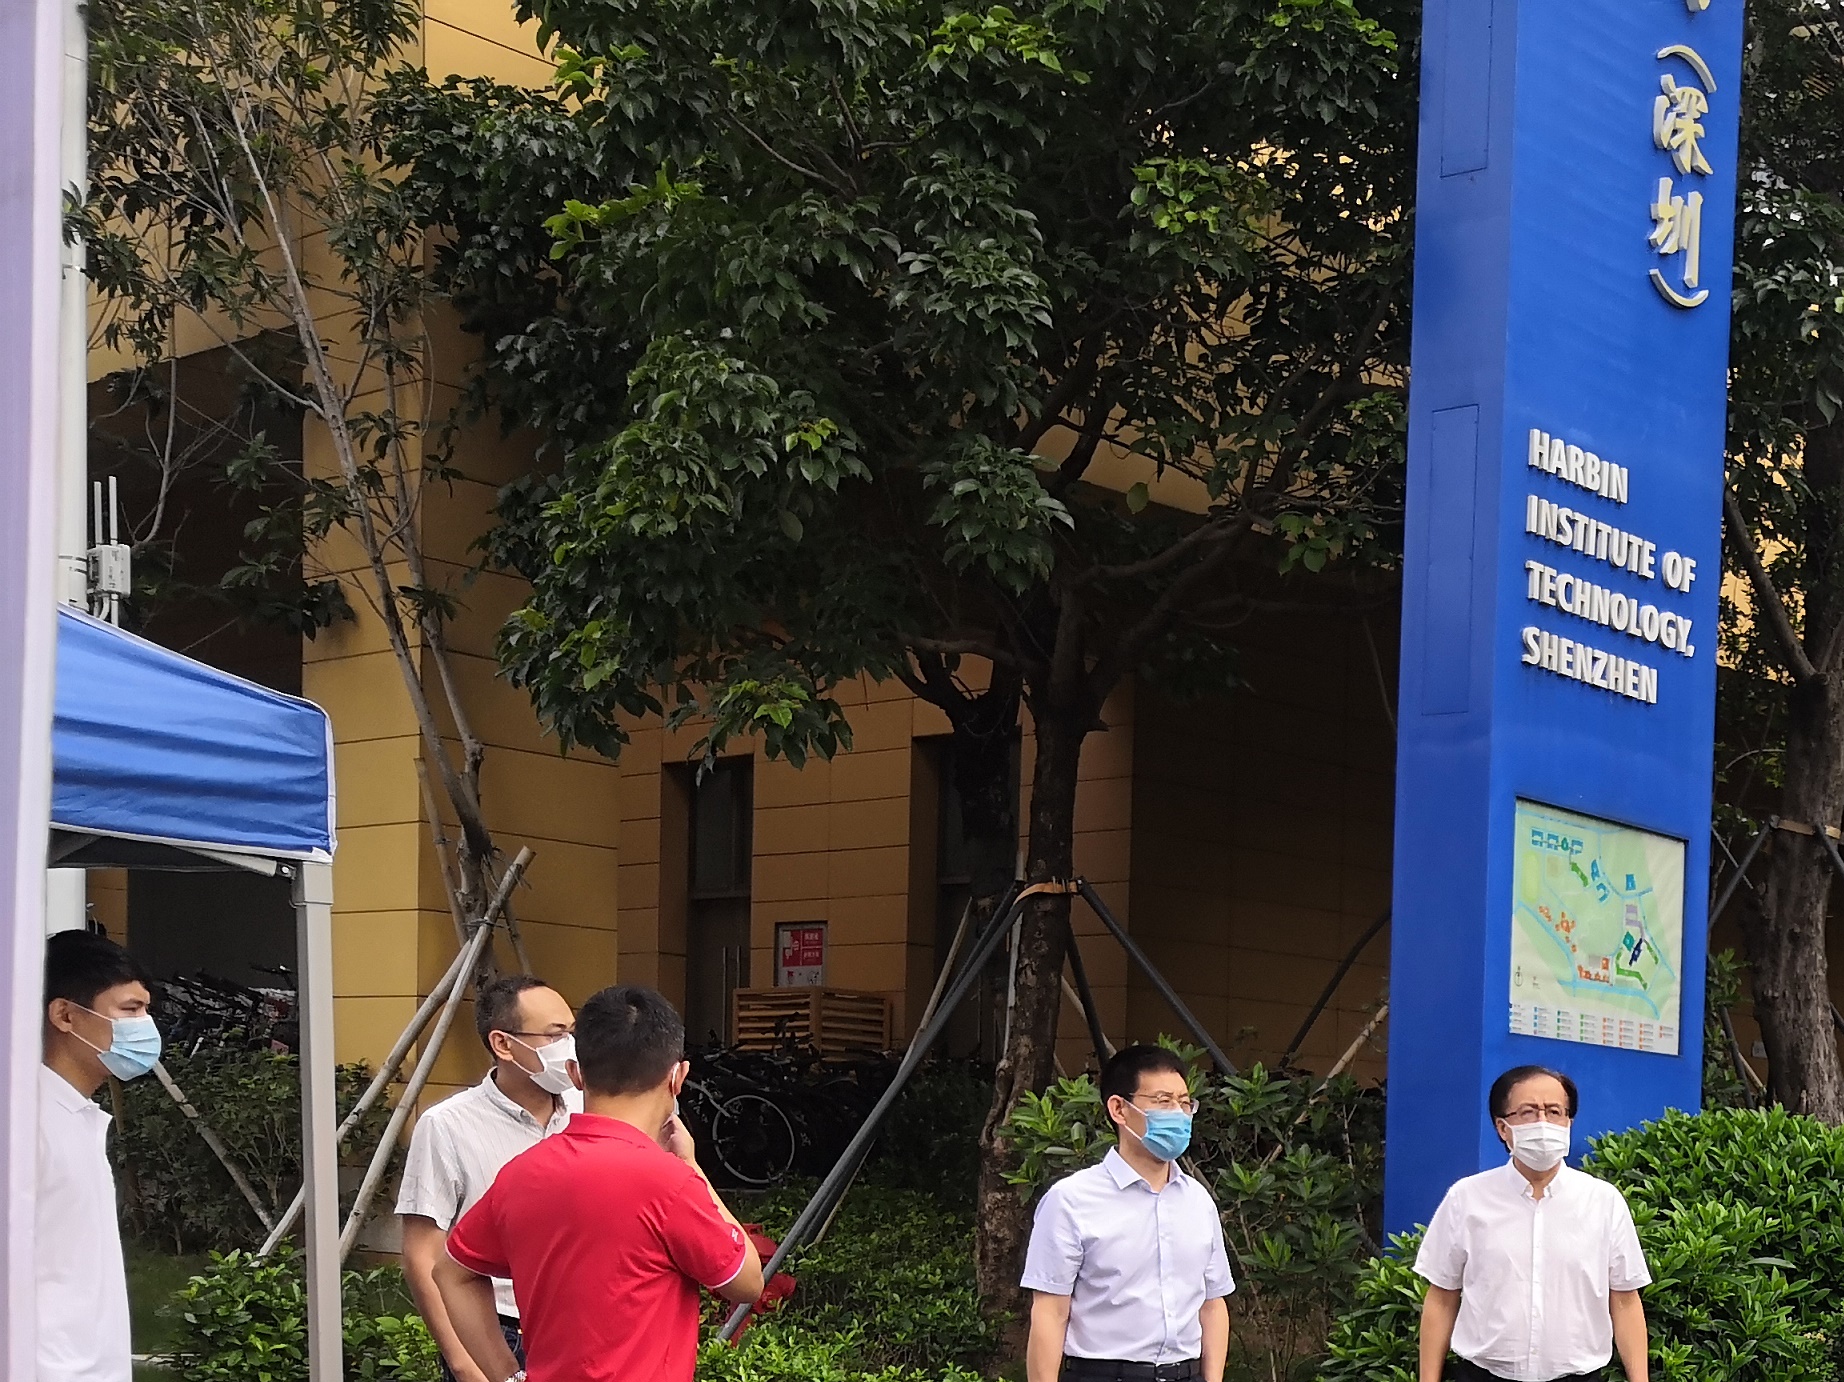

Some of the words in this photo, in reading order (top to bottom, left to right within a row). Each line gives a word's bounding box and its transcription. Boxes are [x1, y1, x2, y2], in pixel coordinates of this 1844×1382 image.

[1650, 0, 1717, 307] (深圳)
[1529, 429, 1629, 504] HARBIN
[1526, 495, 1657, 580] INSTITUTE
[1662, 551, 1697, 593] OF
[1526, 560, 1695, 658] TECHNOLOGY,
[1522, 627, 1658, 704] SHENZHEN
